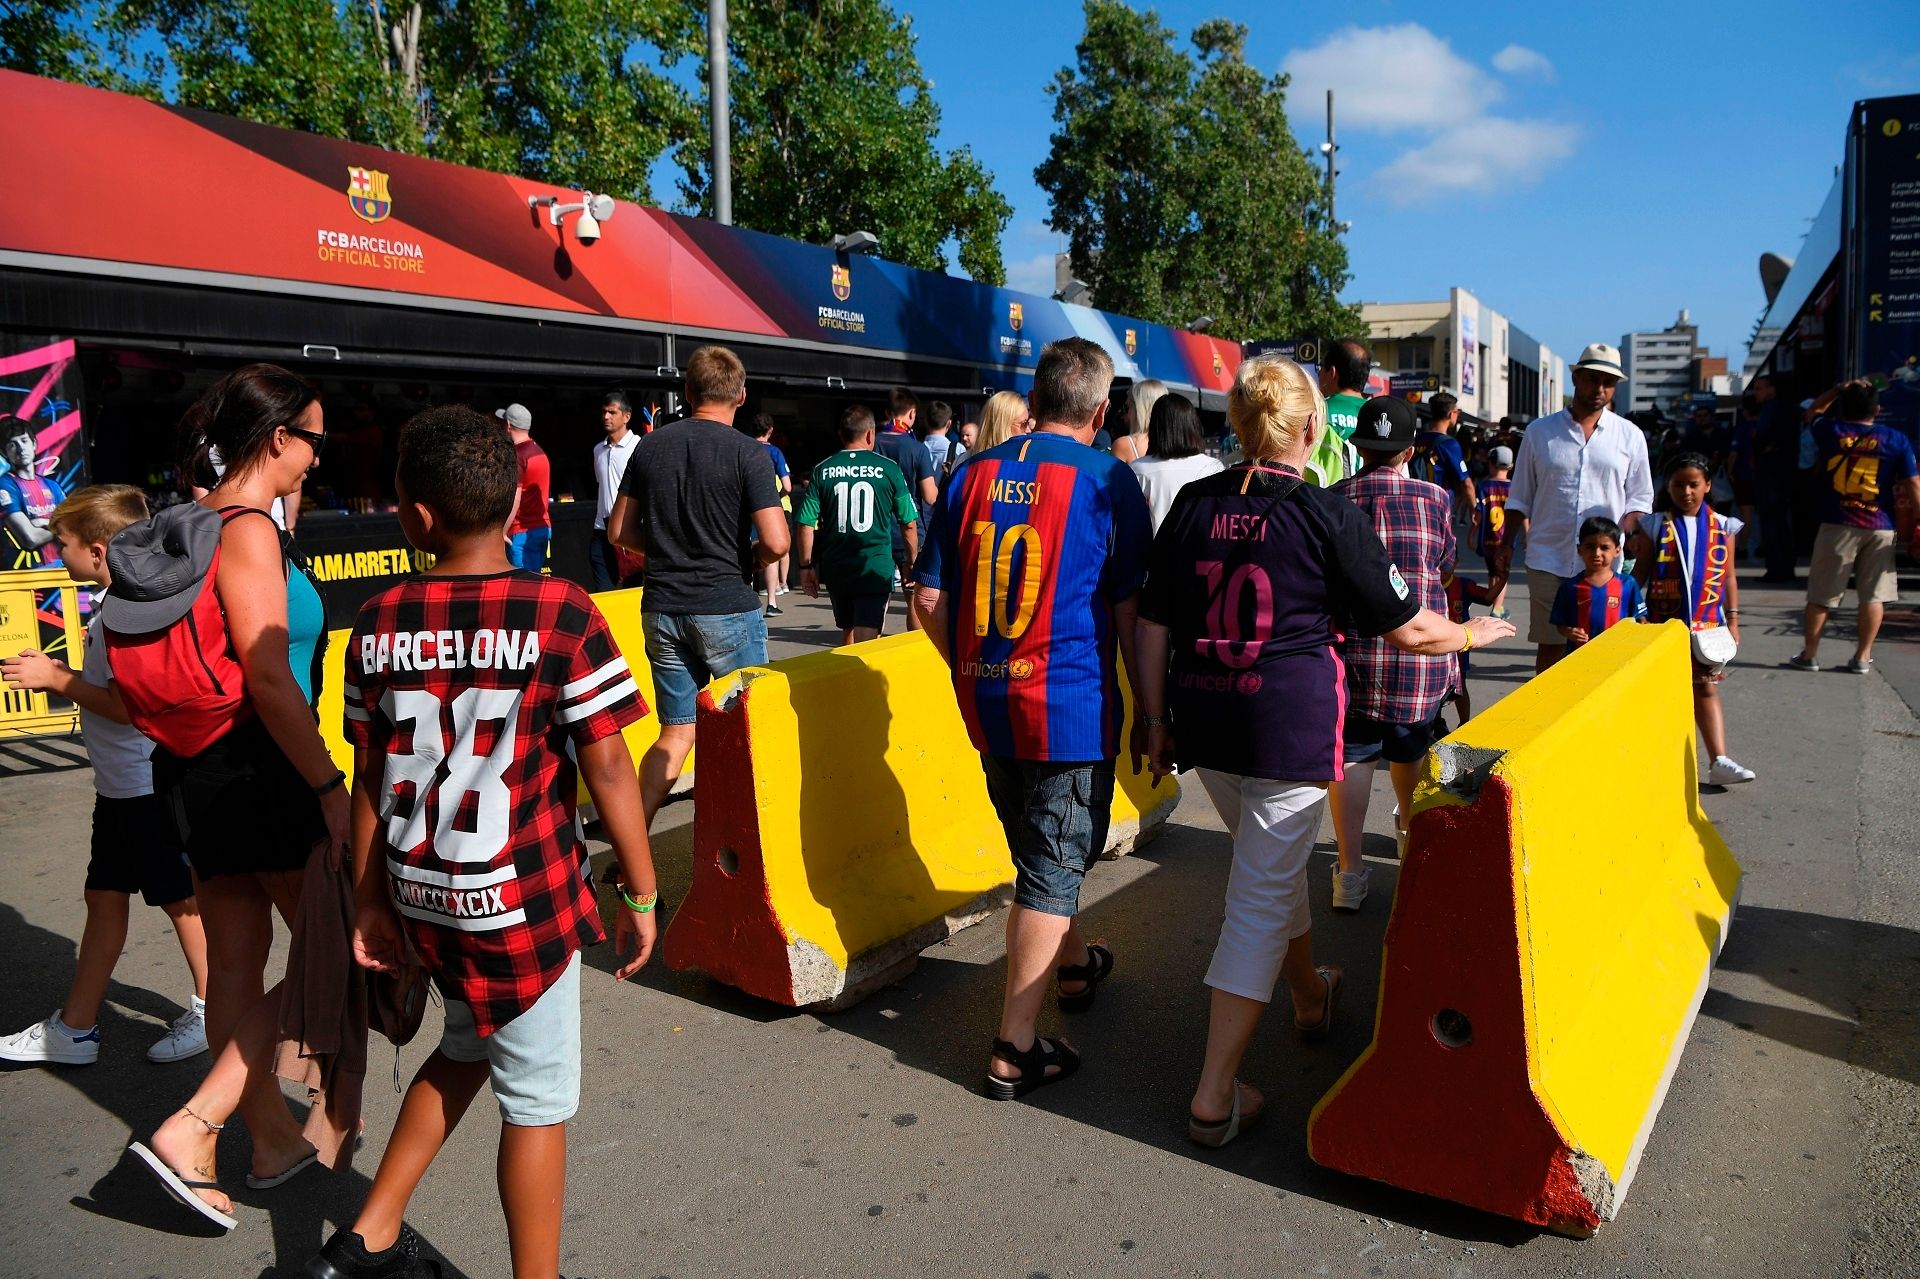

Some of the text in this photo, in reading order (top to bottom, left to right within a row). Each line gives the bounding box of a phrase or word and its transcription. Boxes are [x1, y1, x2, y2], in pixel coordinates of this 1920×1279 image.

[317, 229, 424, 259] FCBARCELONA
[318, 245, 425, 274] OFFICIAL STORE
[818, 306, 865, 323] FCBARCELONA
[819, 317, 866, 334] OFFICIAL STORE
[822, 465, 884, 480] FRANCESC
[986, 478, 1041, 505] MESSI
[833, 481, 875, 533] 10
[1489, 506, 1505, 532] 9
[971, 520, 1042, 639] 10
[1196, 561, 1274, 669] 10
[361, 628, 541, 675] BARCELONA
[961, 658, 1008, 679] unicef
[1178, 671, 1236, 693] unicef
